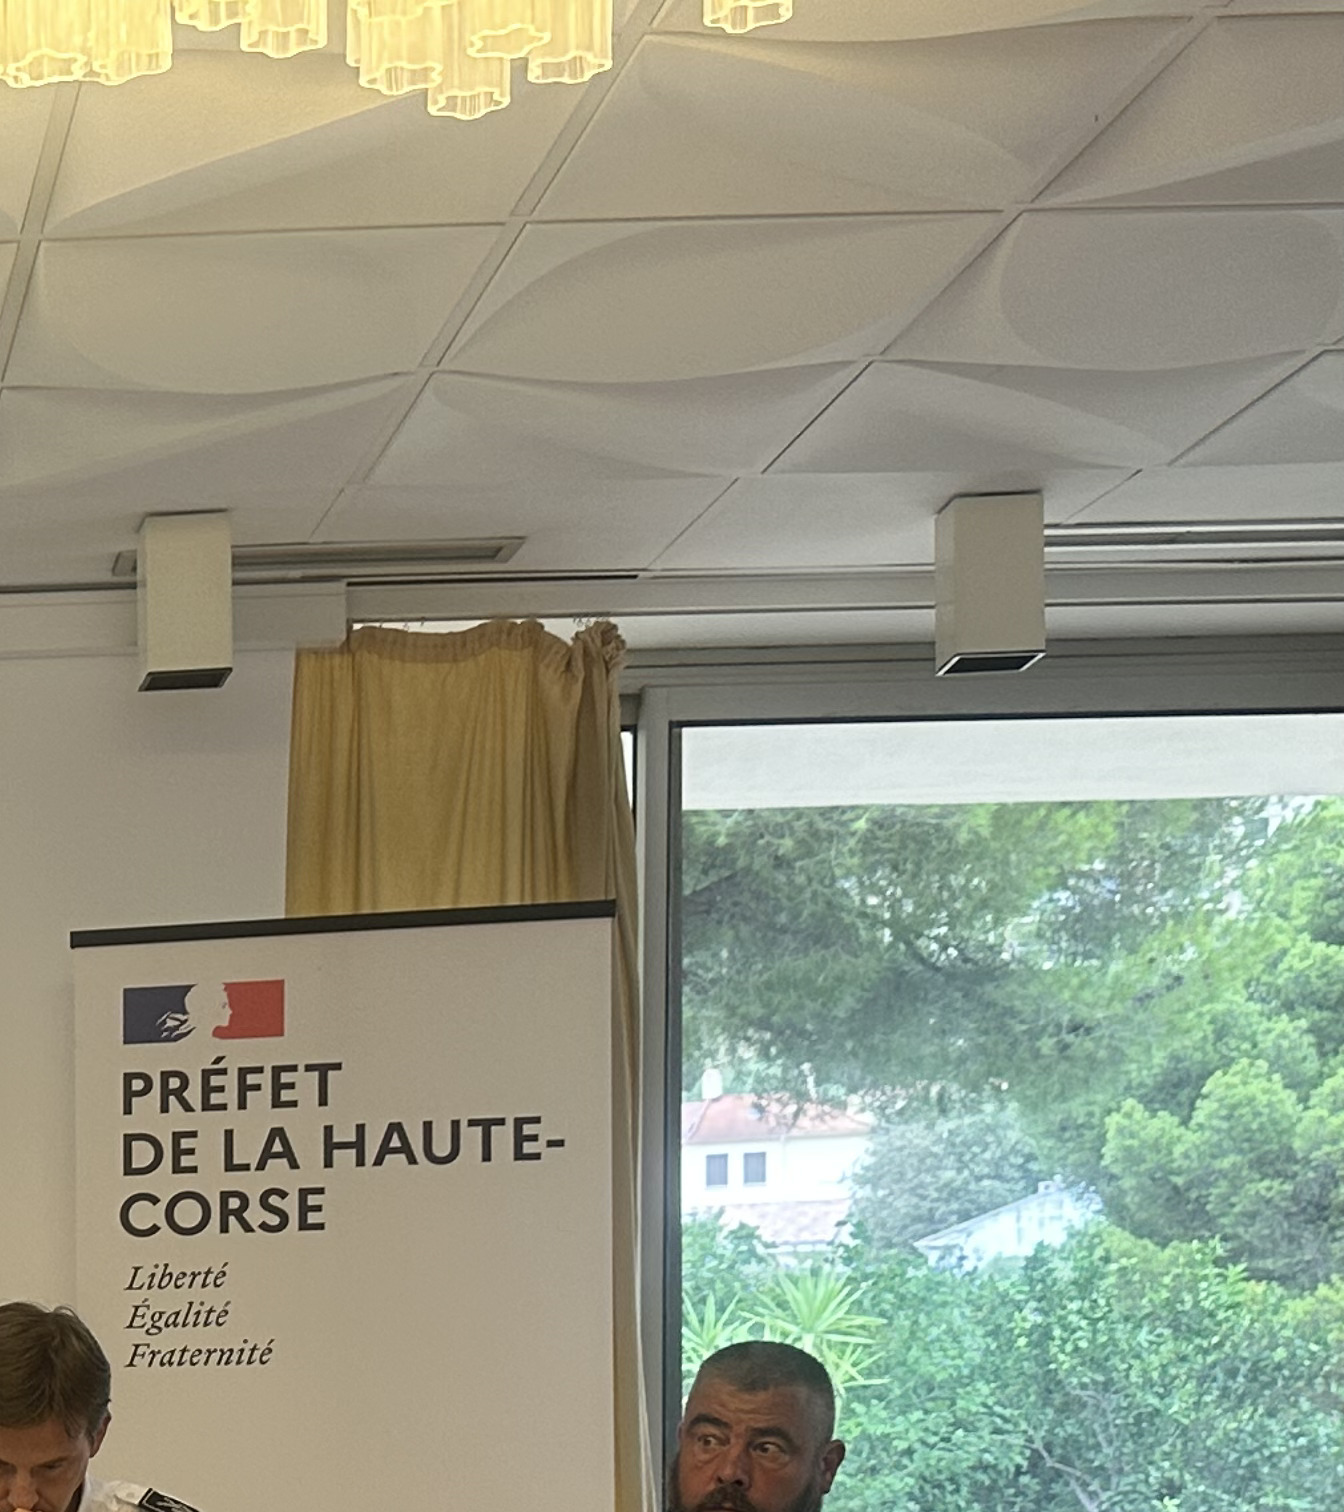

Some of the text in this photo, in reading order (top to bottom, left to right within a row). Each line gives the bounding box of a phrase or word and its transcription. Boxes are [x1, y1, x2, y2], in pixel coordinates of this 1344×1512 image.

[121, 1055, 343, 1116] PRÉFET
[121, 1115, 566, 1177] DE LA HAUTE-
[118, 1186, 326, 1238] CORSE
[123, 1261, 230, 1292] Liberté
[123, 1297, 231, 1337] Égalité
[123, 1337, 274, 1369] Fraternité
